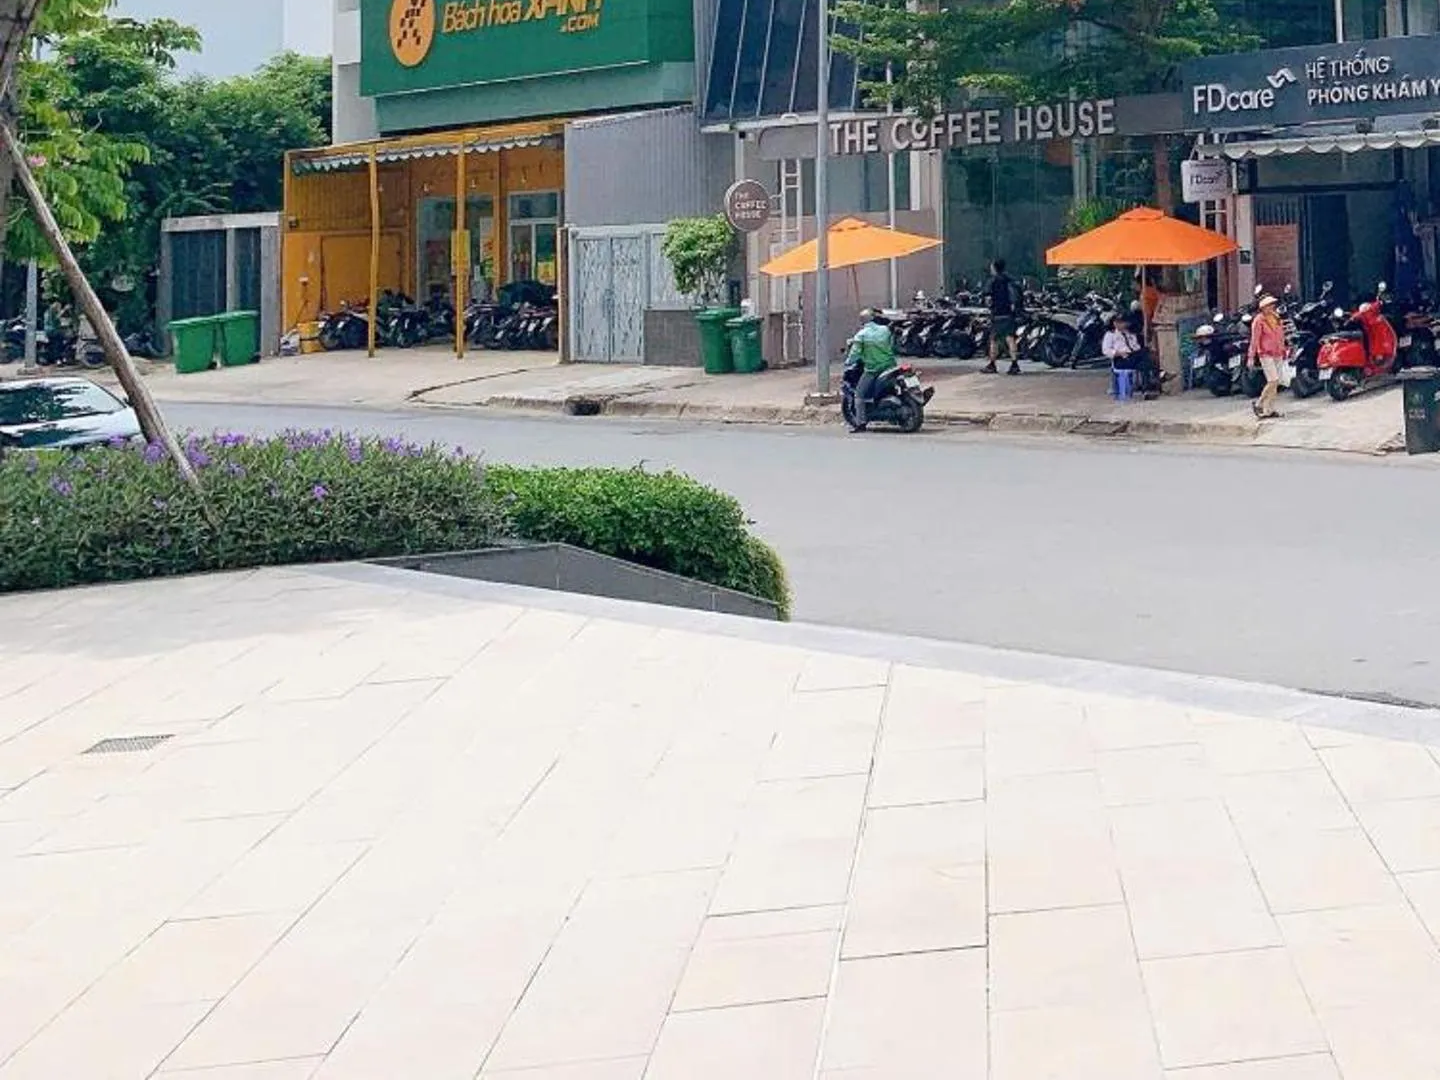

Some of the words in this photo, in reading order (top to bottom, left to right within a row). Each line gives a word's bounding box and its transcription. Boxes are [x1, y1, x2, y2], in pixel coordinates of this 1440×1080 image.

[442, 0, 485, 34] Bách
[1193, 83, 1275, 115] FDcare
[829, 120, 879, 155] THE
[890, 109, 1001, 152] COFFEE
[1014, 98, 1118, 142] HOUSE
